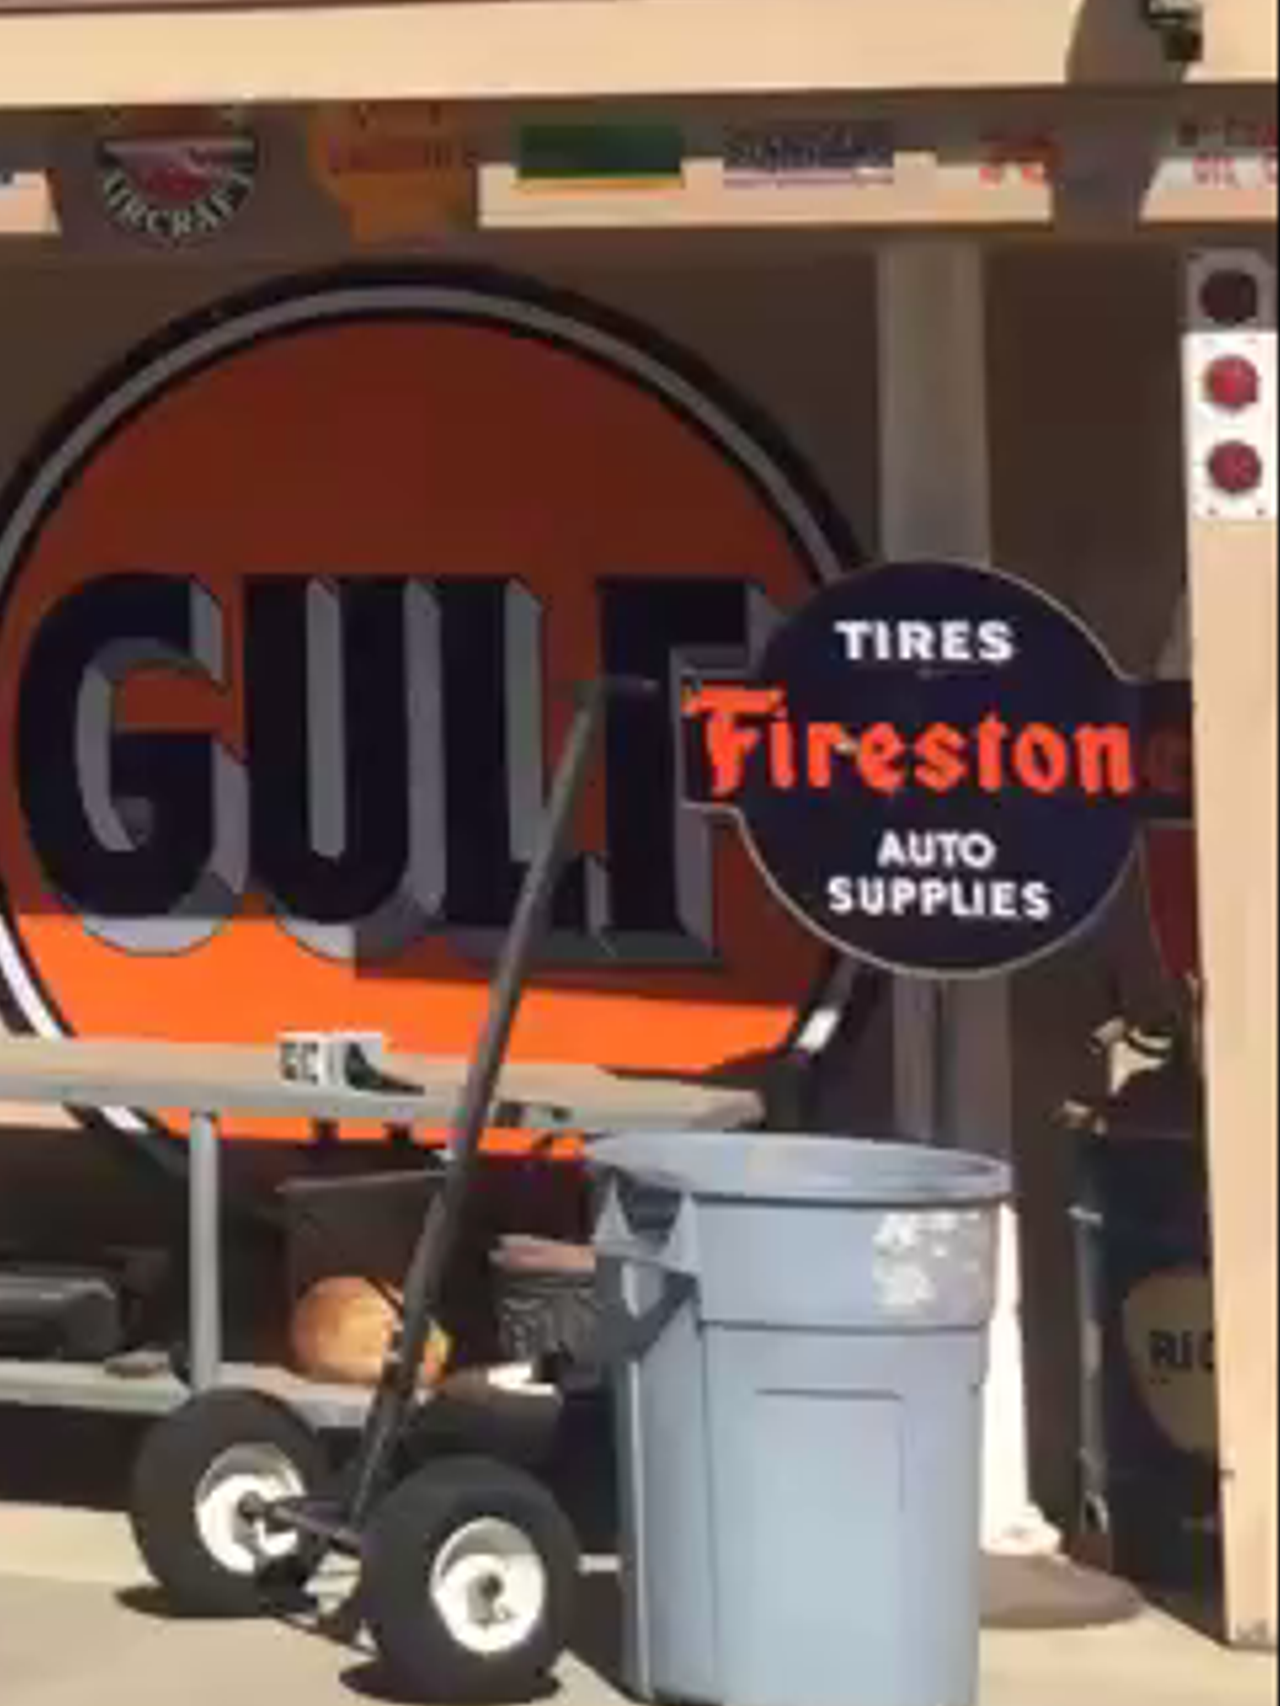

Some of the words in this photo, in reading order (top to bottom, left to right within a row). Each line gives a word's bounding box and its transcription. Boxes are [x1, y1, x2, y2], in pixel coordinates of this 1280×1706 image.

[835, 620, 1017, 663] TIRES
[18, 572, 765, 954] GULF
[876, 830, 997, 869] AUTO
[827, 877, 1053, 922] SUPPLIES
